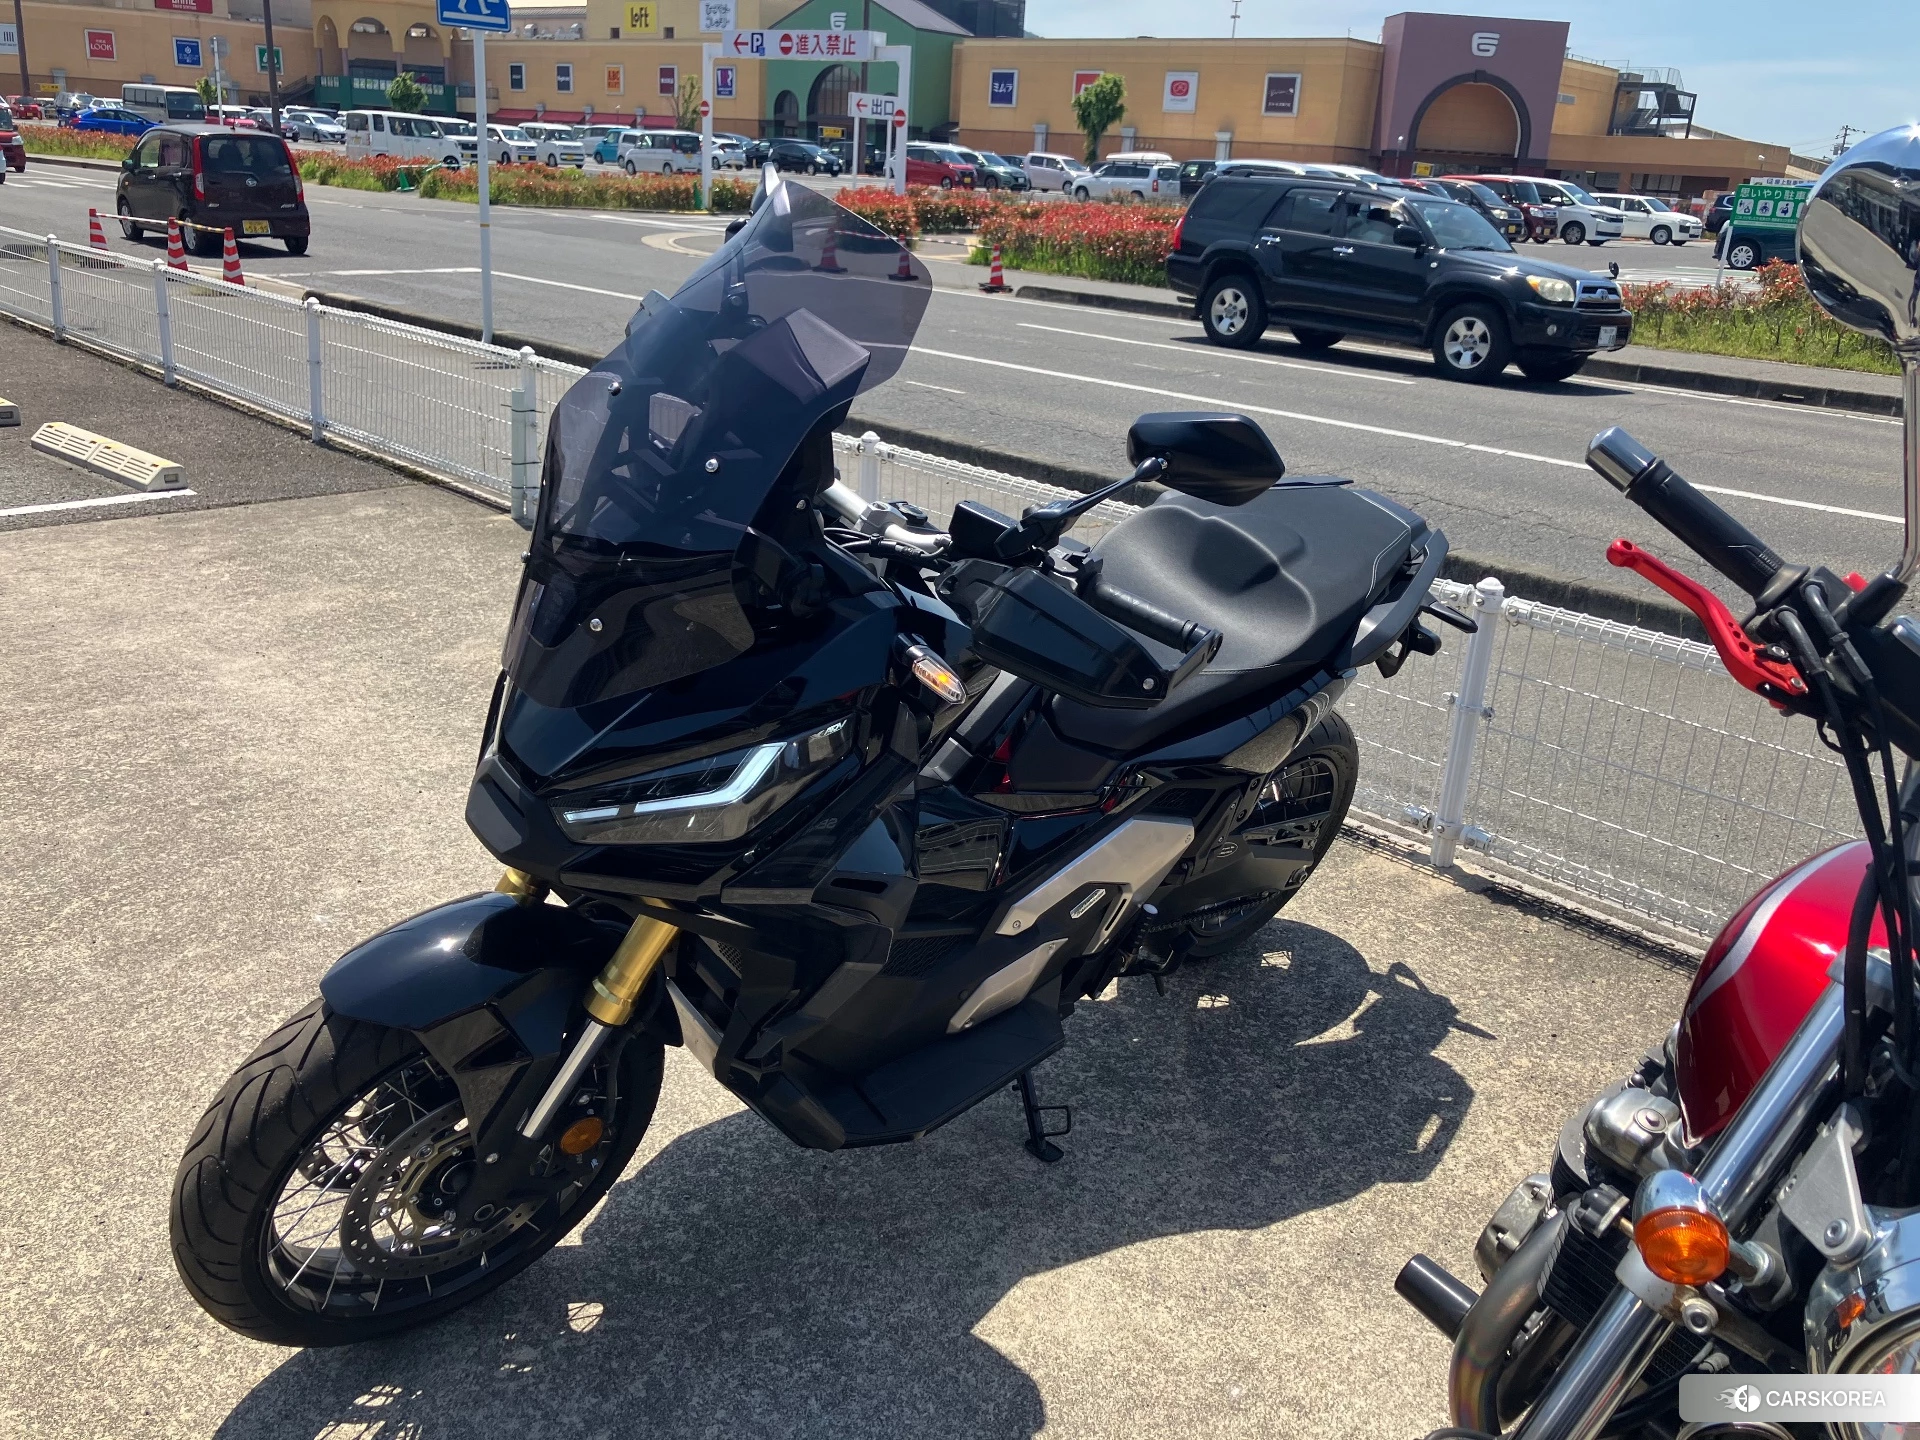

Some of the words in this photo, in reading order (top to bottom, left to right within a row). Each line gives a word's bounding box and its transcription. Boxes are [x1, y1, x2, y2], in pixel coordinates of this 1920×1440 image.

[90, 43, 112, 51] LOOK
[796, 34, 856, 56] 進入禁止
[871, 98, 895, 116] 出口
